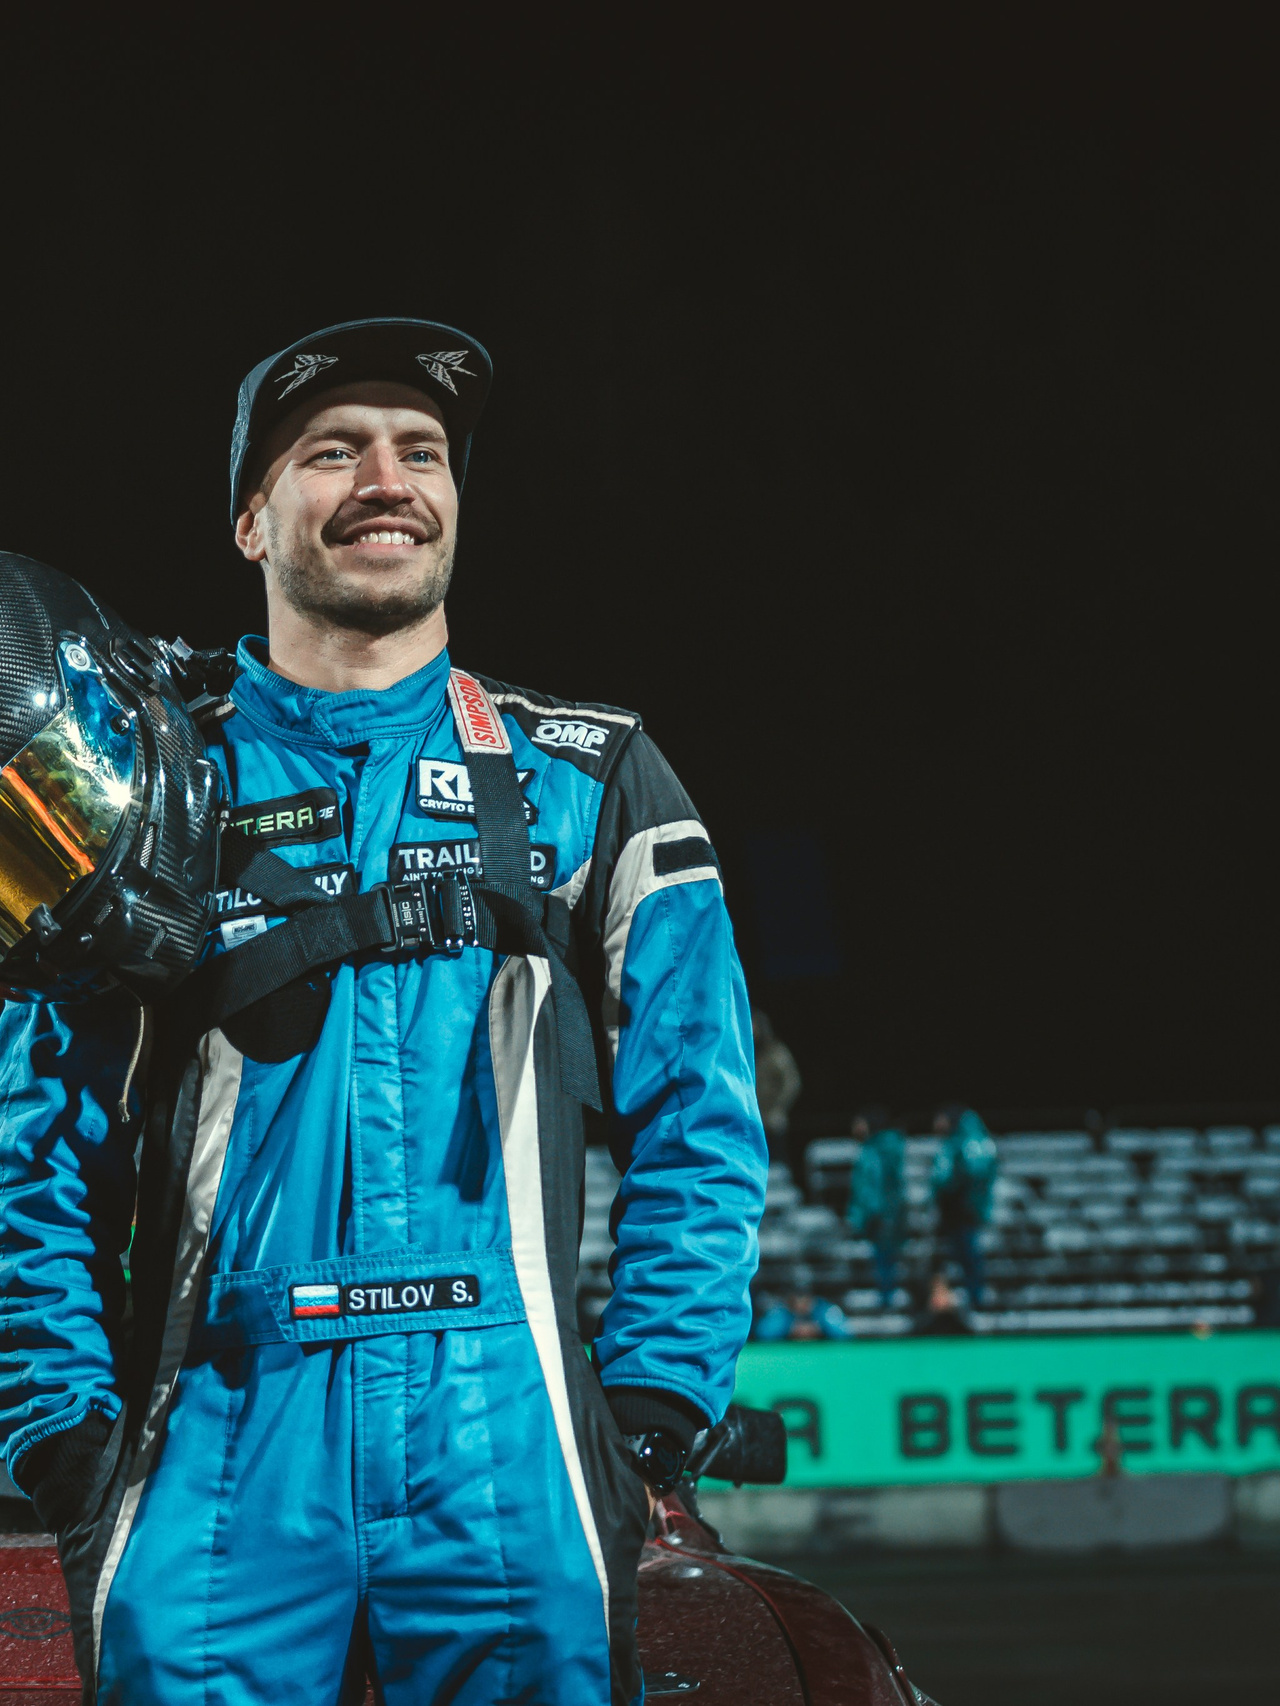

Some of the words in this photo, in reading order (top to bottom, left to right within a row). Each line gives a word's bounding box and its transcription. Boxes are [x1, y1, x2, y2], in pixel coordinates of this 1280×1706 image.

[456, 676, 496, 744] SIMPSON
[535, 724, 606, 748] OMP
[420, 798, 466, 813] CRYPTO
[231, 806, 314, 836] TERA
[348, 1283, 434, 1311] STILOV
[452, 1280, 474, 1303] S.
